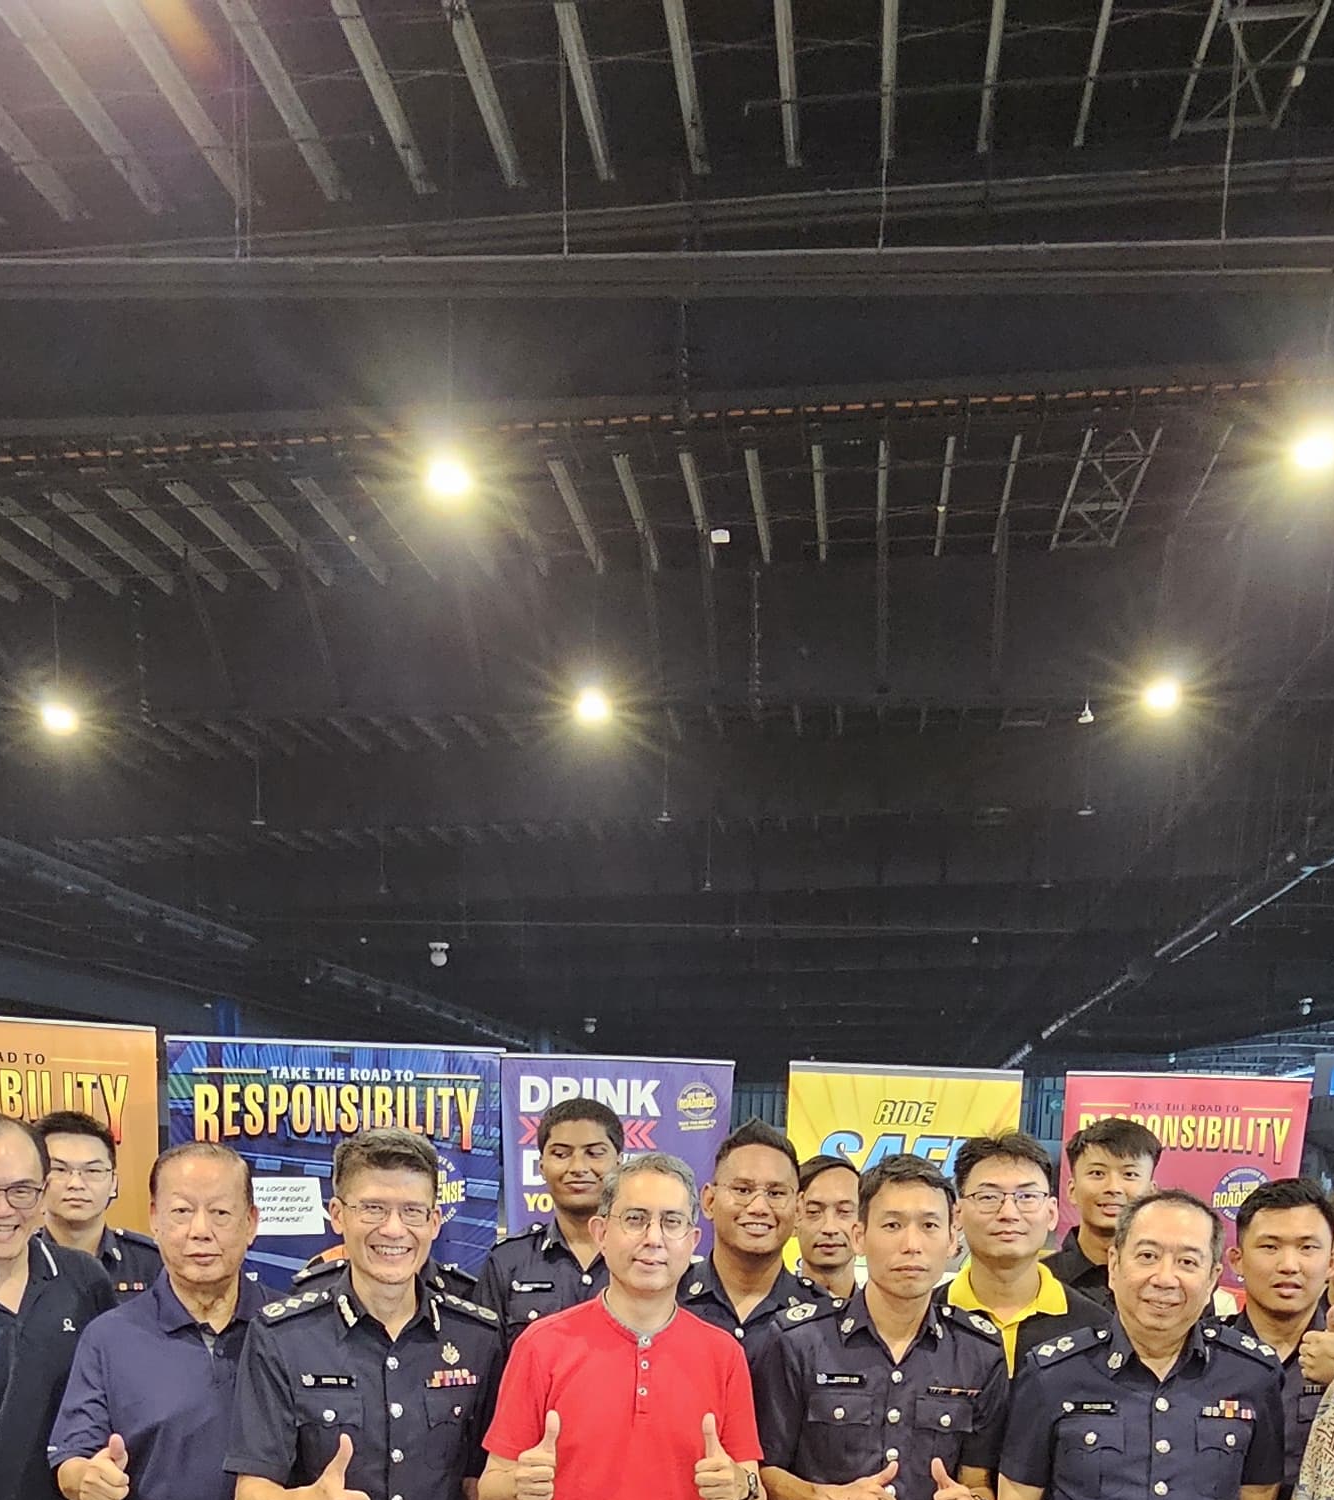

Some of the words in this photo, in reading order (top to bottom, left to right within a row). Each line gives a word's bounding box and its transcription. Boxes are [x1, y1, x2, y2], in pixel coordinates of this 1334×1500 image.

[23, 1052, 47, 1066] TO
[271, 1065, 311, 1080] TAKE
[315, 1067, 346, 1081] THE
[350, 1068, 391, 1082] ROAD
[394, 1069, 415, 1082] TO
[519, 1075, 662, 1117] DRINK
[193, 1083, 479, 1151] RESPONSIBILITY
[874, 1100, 936, 1126] RIDE
[1133, 1102, 1160, 1111] TAKE
[1166, 1103, 1186, 1112] THE
[1192, 1103, 1222, 1112] ROAD
[1225, 1104, 1240, 1112] TO
